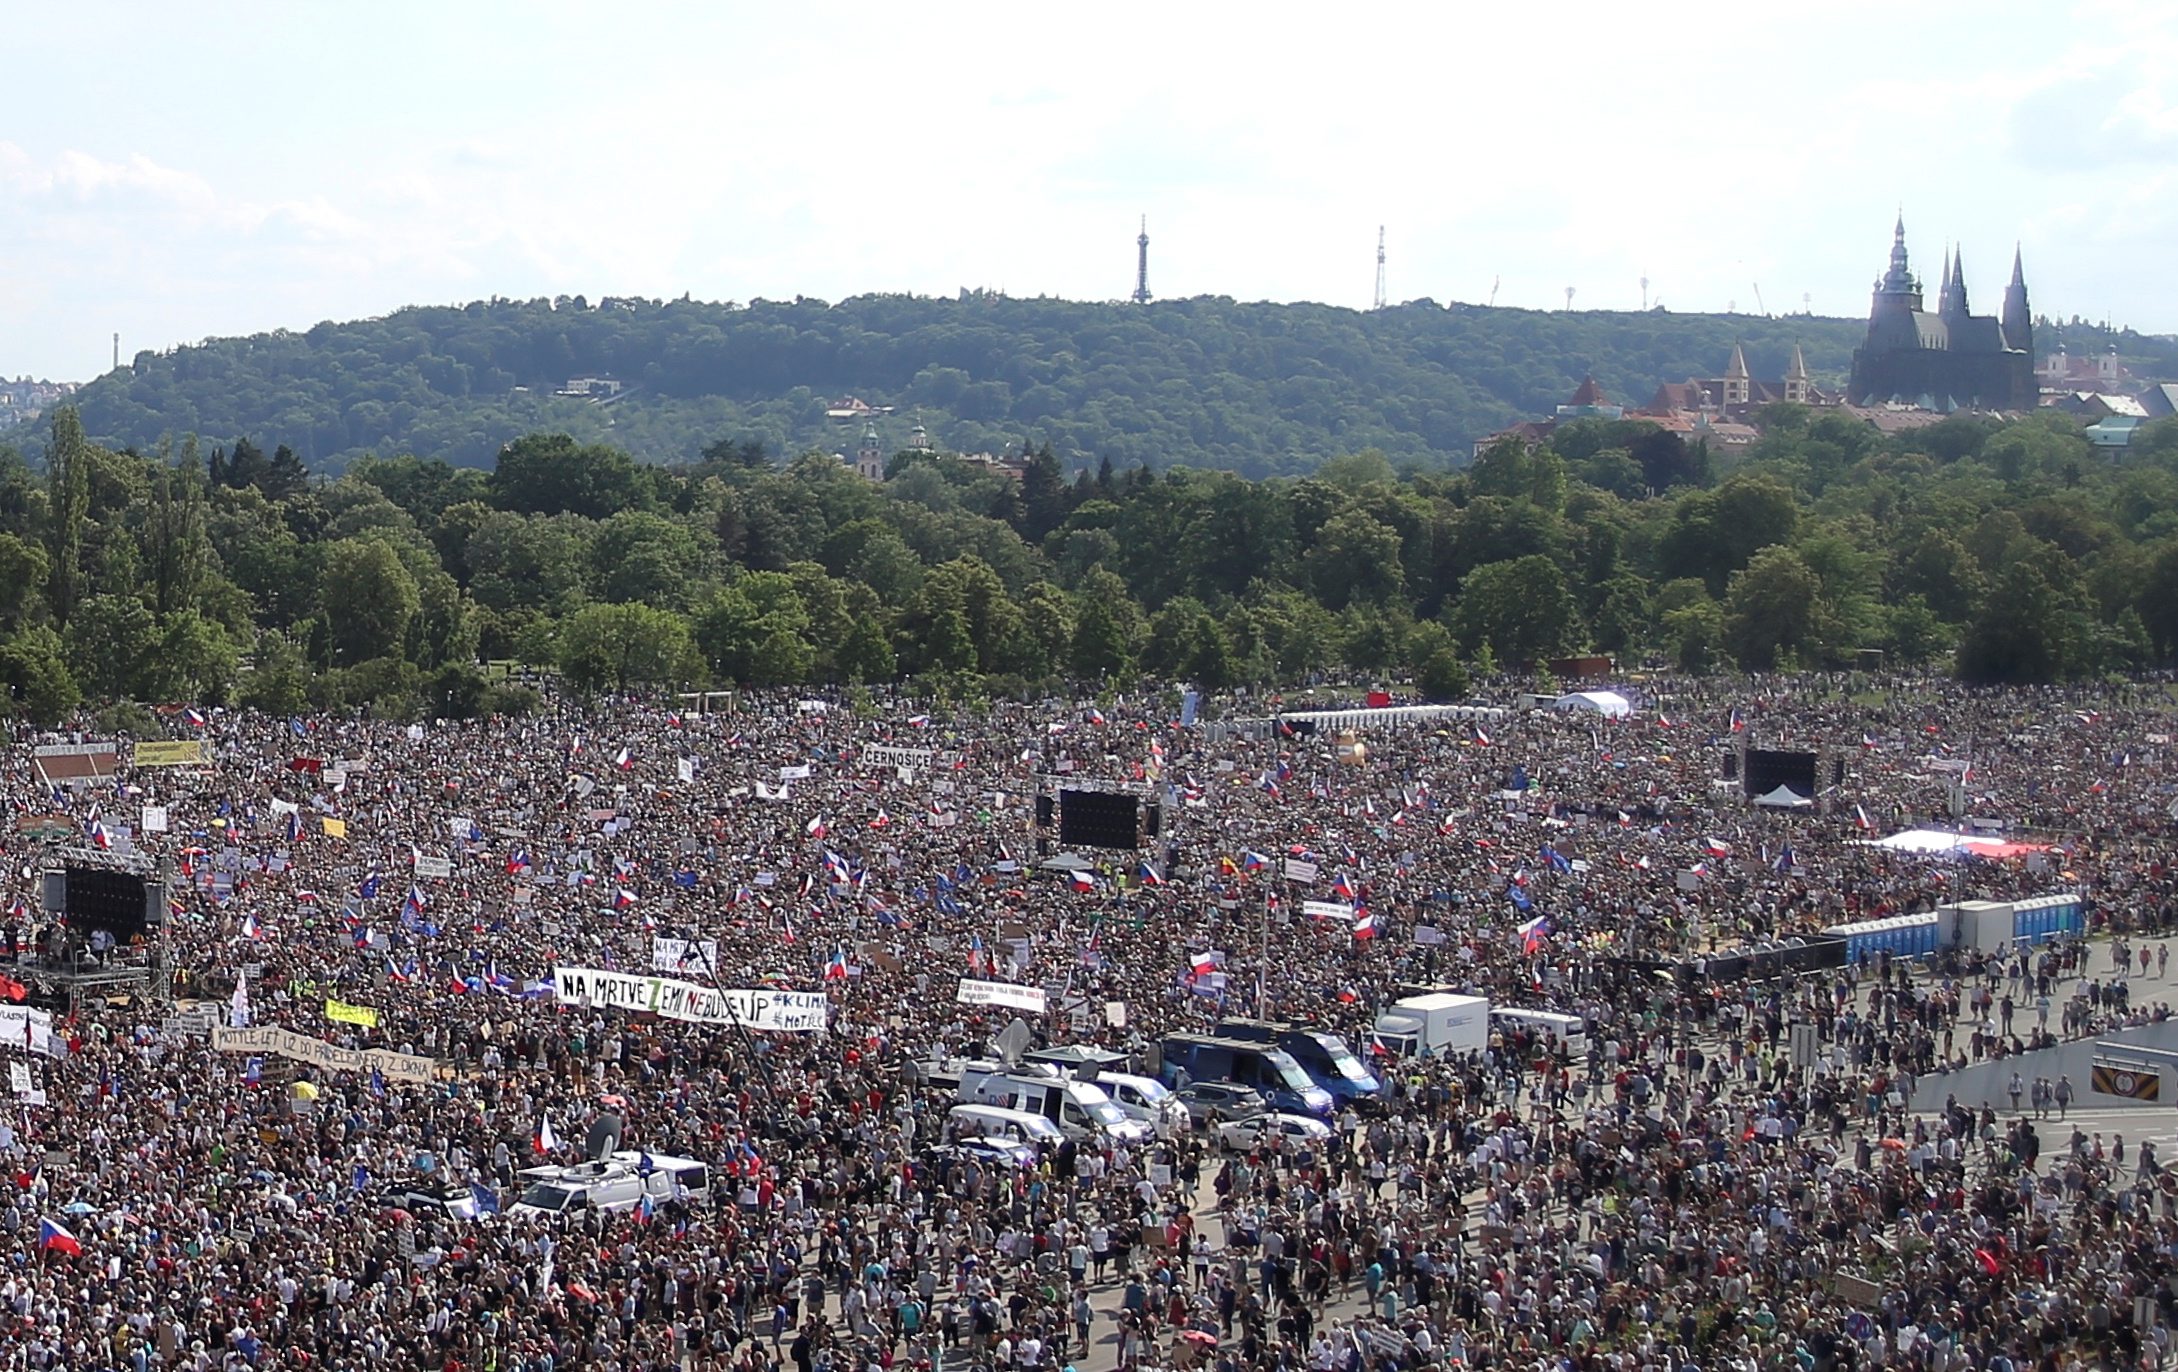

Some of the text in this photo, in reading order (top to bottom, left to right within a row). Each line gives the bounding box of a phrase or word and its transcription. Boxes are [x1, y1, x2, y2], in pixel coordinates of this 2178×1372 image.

[865, 746, 930, 769] ČERNOŠICE
[562, 974, 586, 997] NA
[594, 977, 647, 1005] MRTVÉ
[300, 1039, 312, 1056] DO
[387, 1056, 396, 1071] Z
